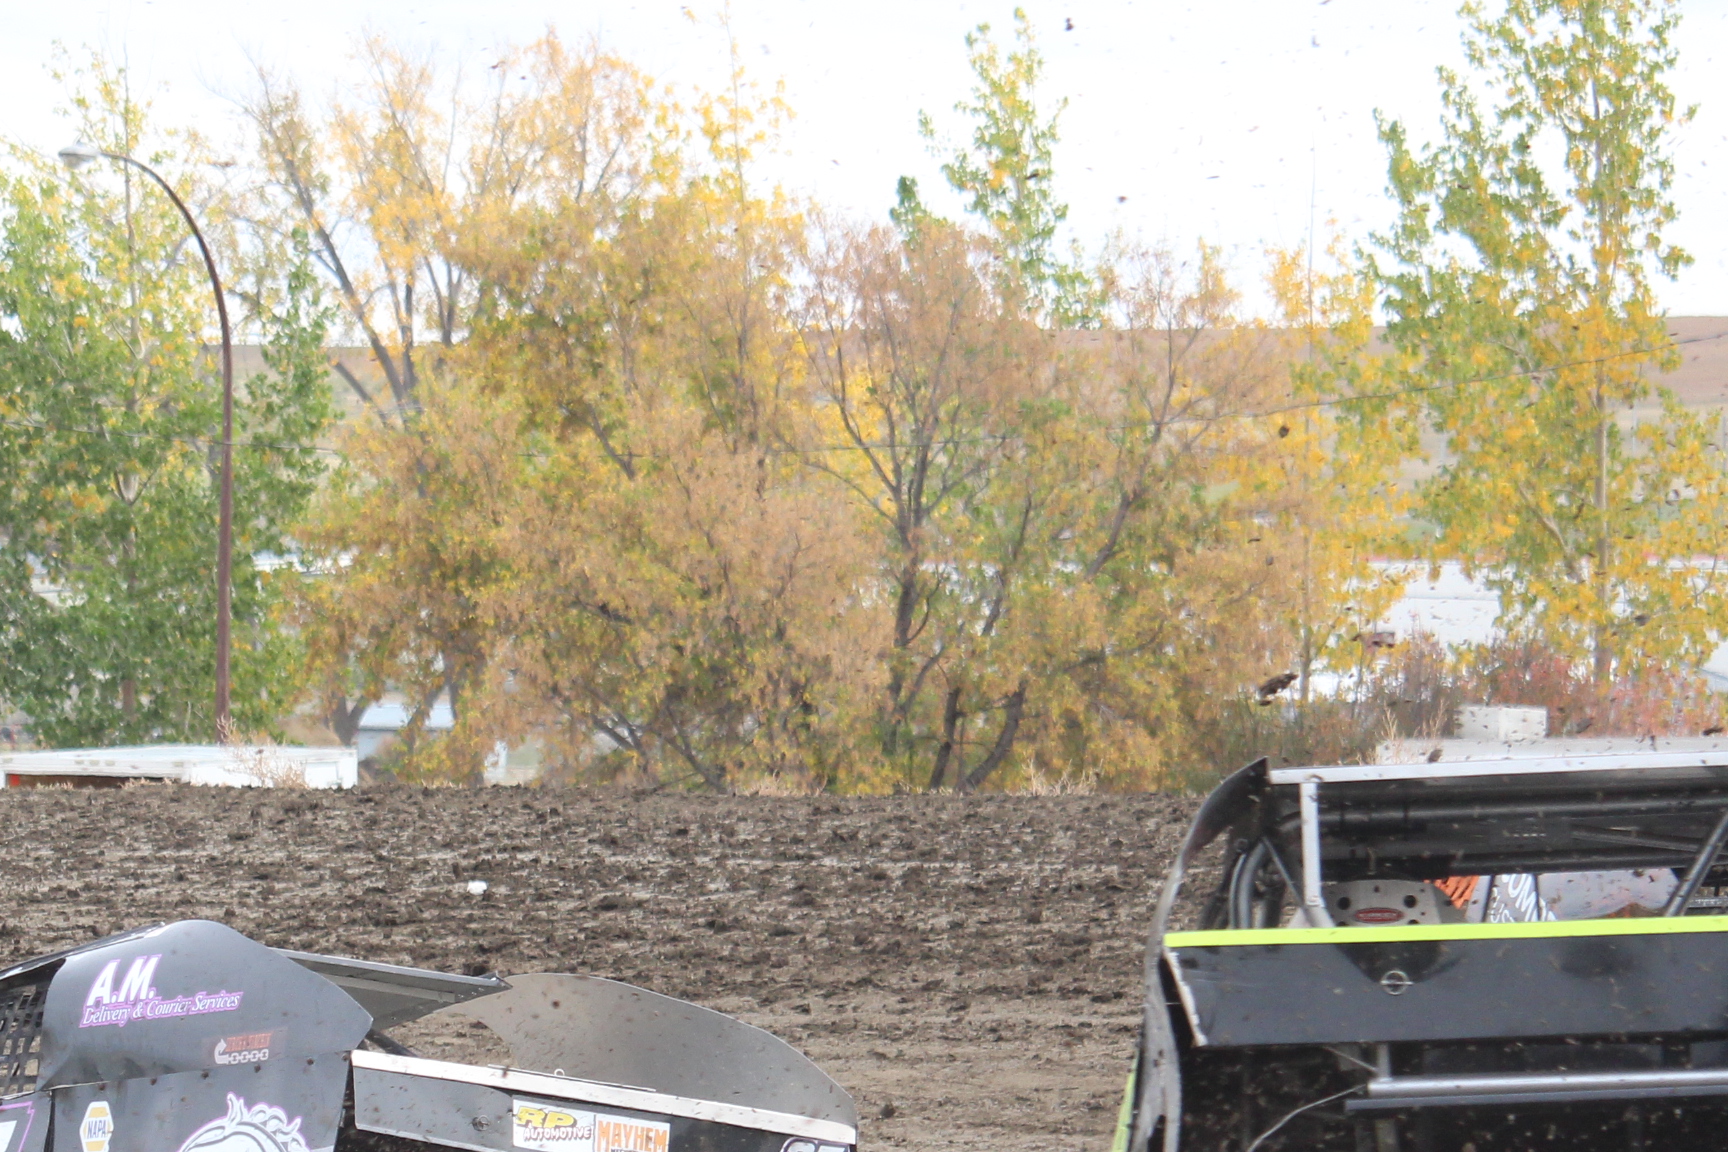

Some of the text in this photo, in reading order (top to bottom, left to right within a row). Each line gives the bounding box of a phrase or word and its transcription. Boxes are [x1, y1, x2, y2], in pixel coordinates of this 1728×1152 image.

[86, 955, 161, 1007] A.M.
[82, 993, 241, 1026] Delivery & Courier Services
[87, 1119, 107, 1139] NAPA
[515, 1106, 577, 1129] RP
[523, 1124, 593, 1142] AUTOMOTIVE
